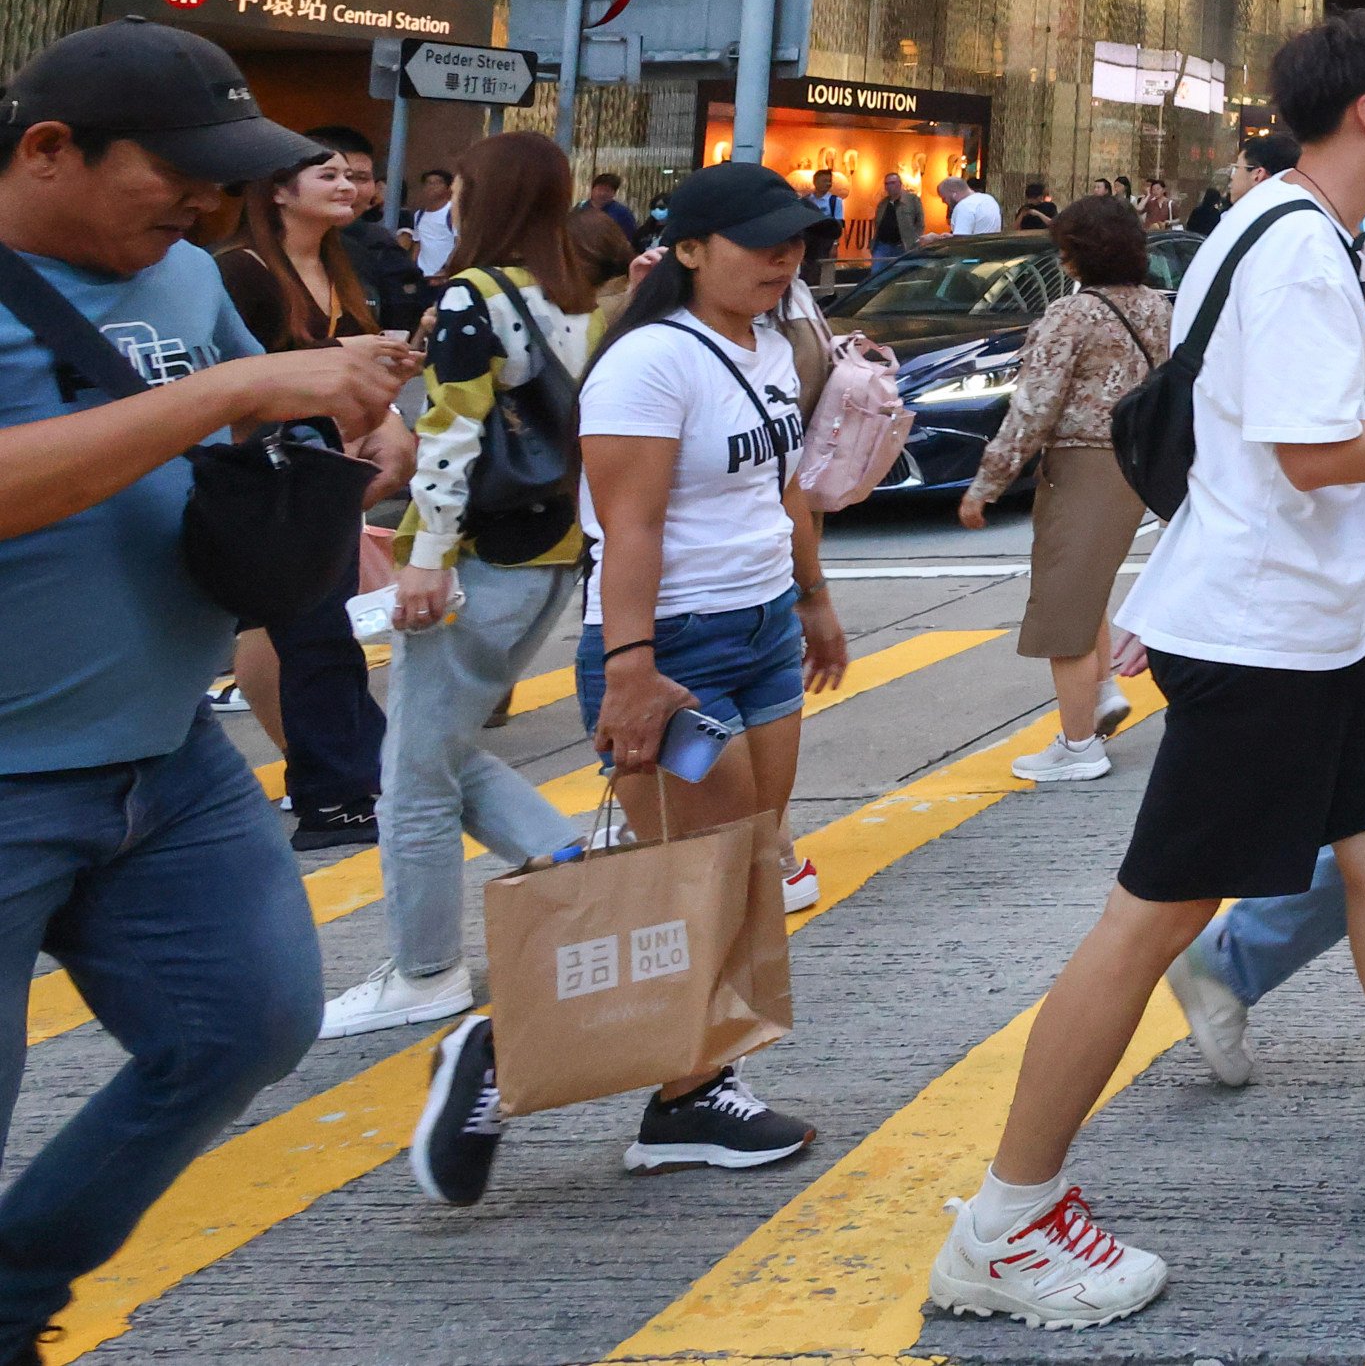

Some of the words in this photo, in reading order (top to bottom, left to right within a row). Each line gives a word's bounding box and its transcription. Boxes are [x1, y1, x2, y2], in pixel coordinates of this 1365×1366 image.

[333, 4, 392, 28] Central
[395, 12, 450, 34] Station
[425, 49, 474, 67] Pedder
[477, 54, 516, 72] Street
[807, 83, 852, 107] LOUIS
[857, 89, 917, 113] VUITTON
[637, 928, 685, 952] UNI
[566, 943, 608, 969] ユニ
[638, 947, 684, 973] QLO
